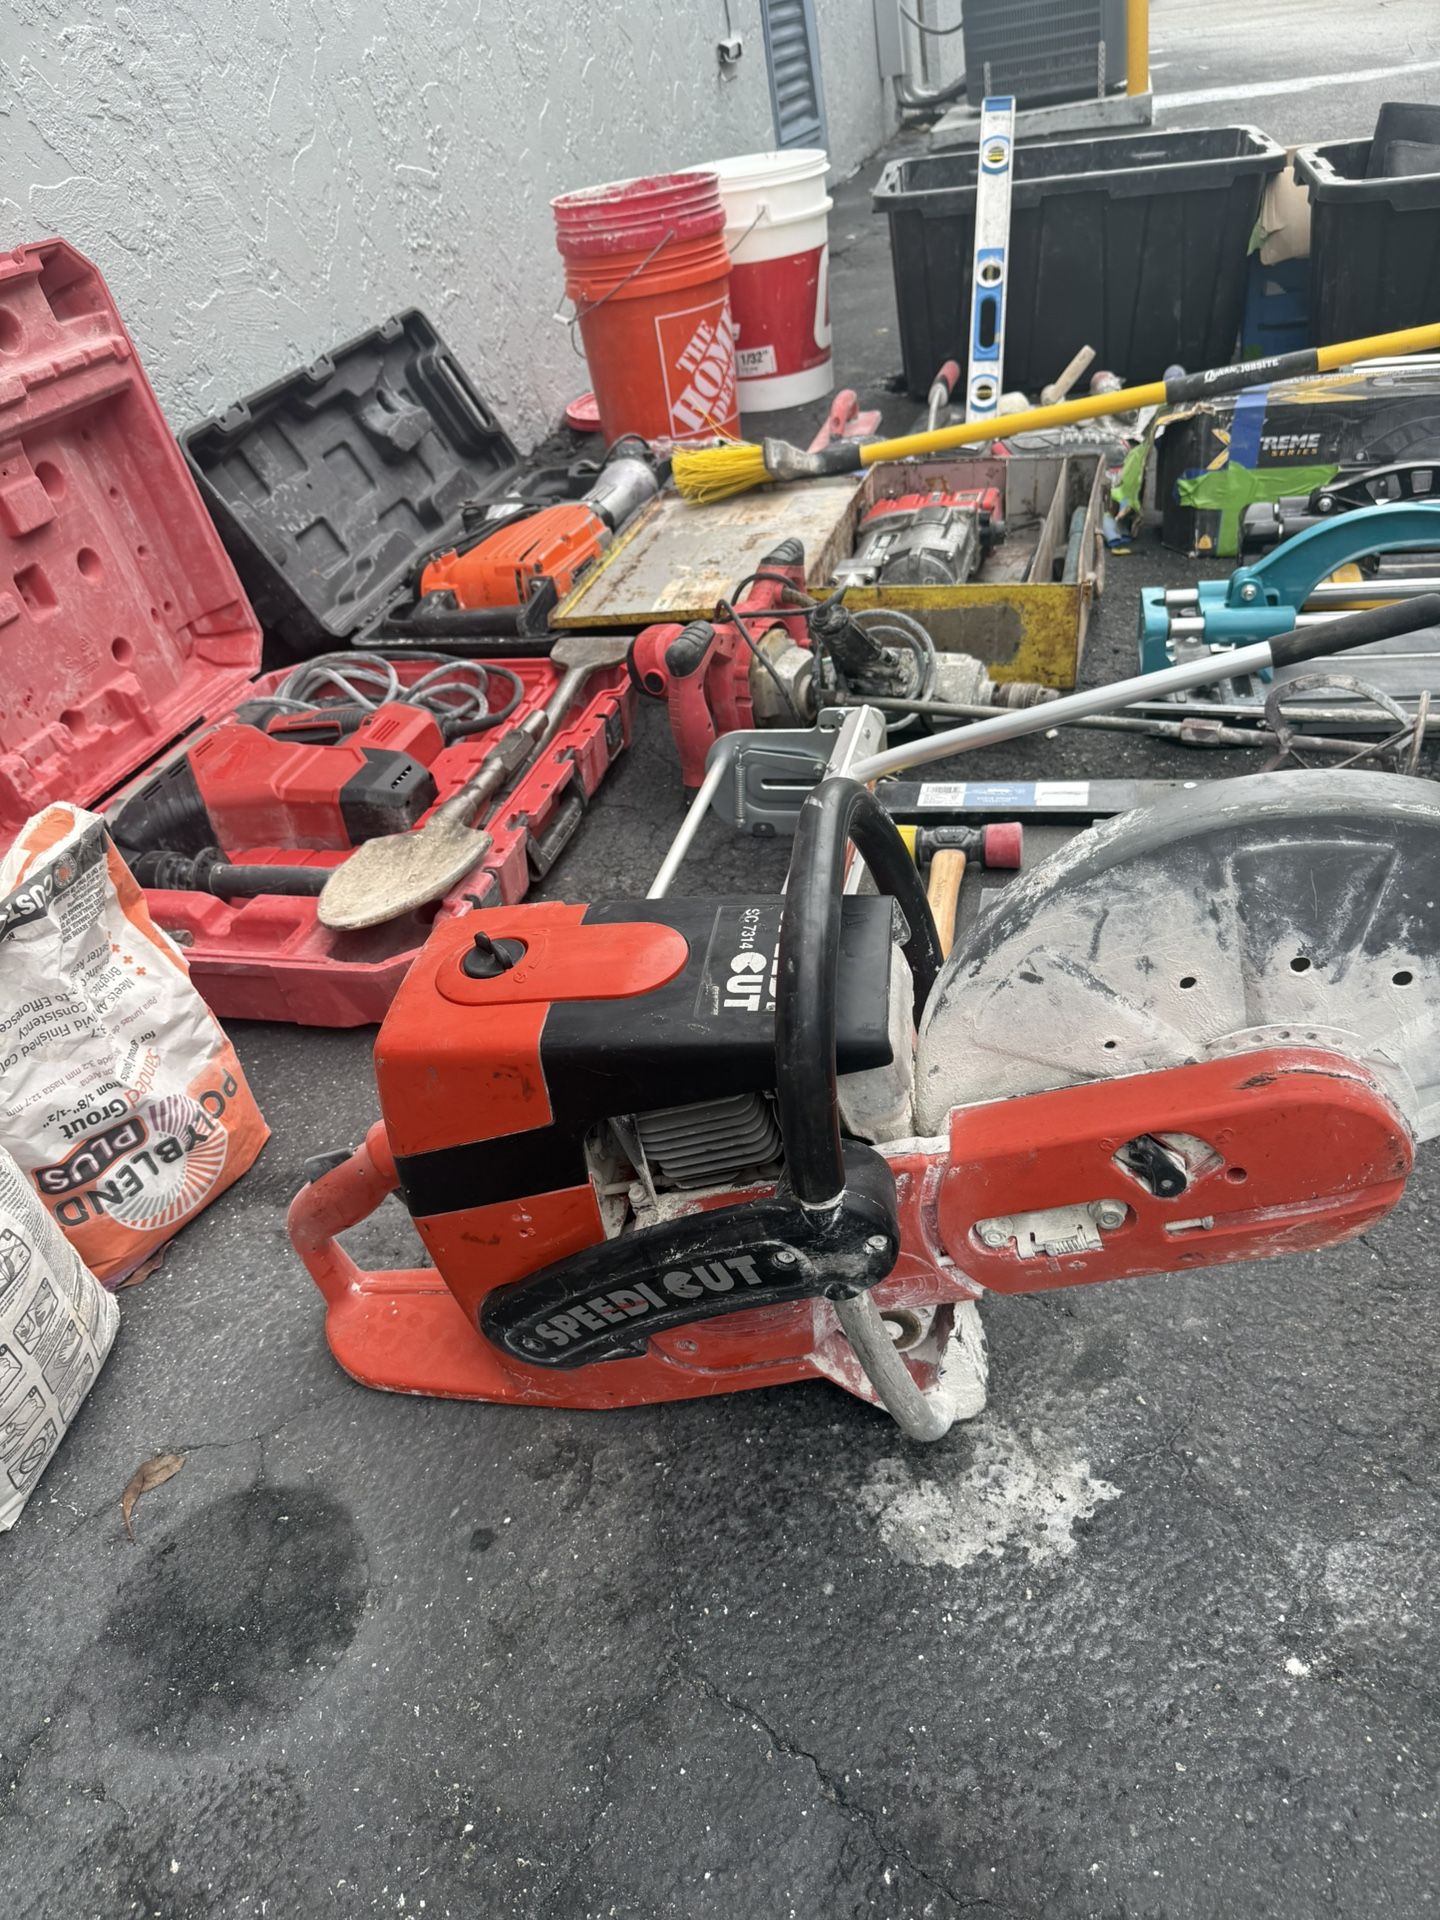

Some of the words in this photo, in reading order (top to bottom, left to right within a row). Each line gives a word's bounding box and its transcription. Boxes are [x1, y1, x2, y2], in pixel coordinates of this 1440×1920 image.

[675, 320, 715, 374] THE
[1271, 448, 1318, 457] SERIES
[744, 908, 760, 923] SC
[739, 925, 757, 949] 7314
[54, 993, 70, 1002] to
[108, 978, 135, 1001] Meets
[723, 951, 767, 1011] CUT
[19, 1001, 87, 1040] Consistency
[140, 1030, 156, 1043] for
[21, 1023, 71, 1057] Finished
[43, 1079, 66, 1096] hasta
[124, 1048, 160, 1109] Sanded
[59, 1098, 128, 1139] Grout
[43, 1125, 137, 1190] PLUS
[535, 1282, 667, 1347] SPEEDI
[663, 1255, 763, 1299] CUT
